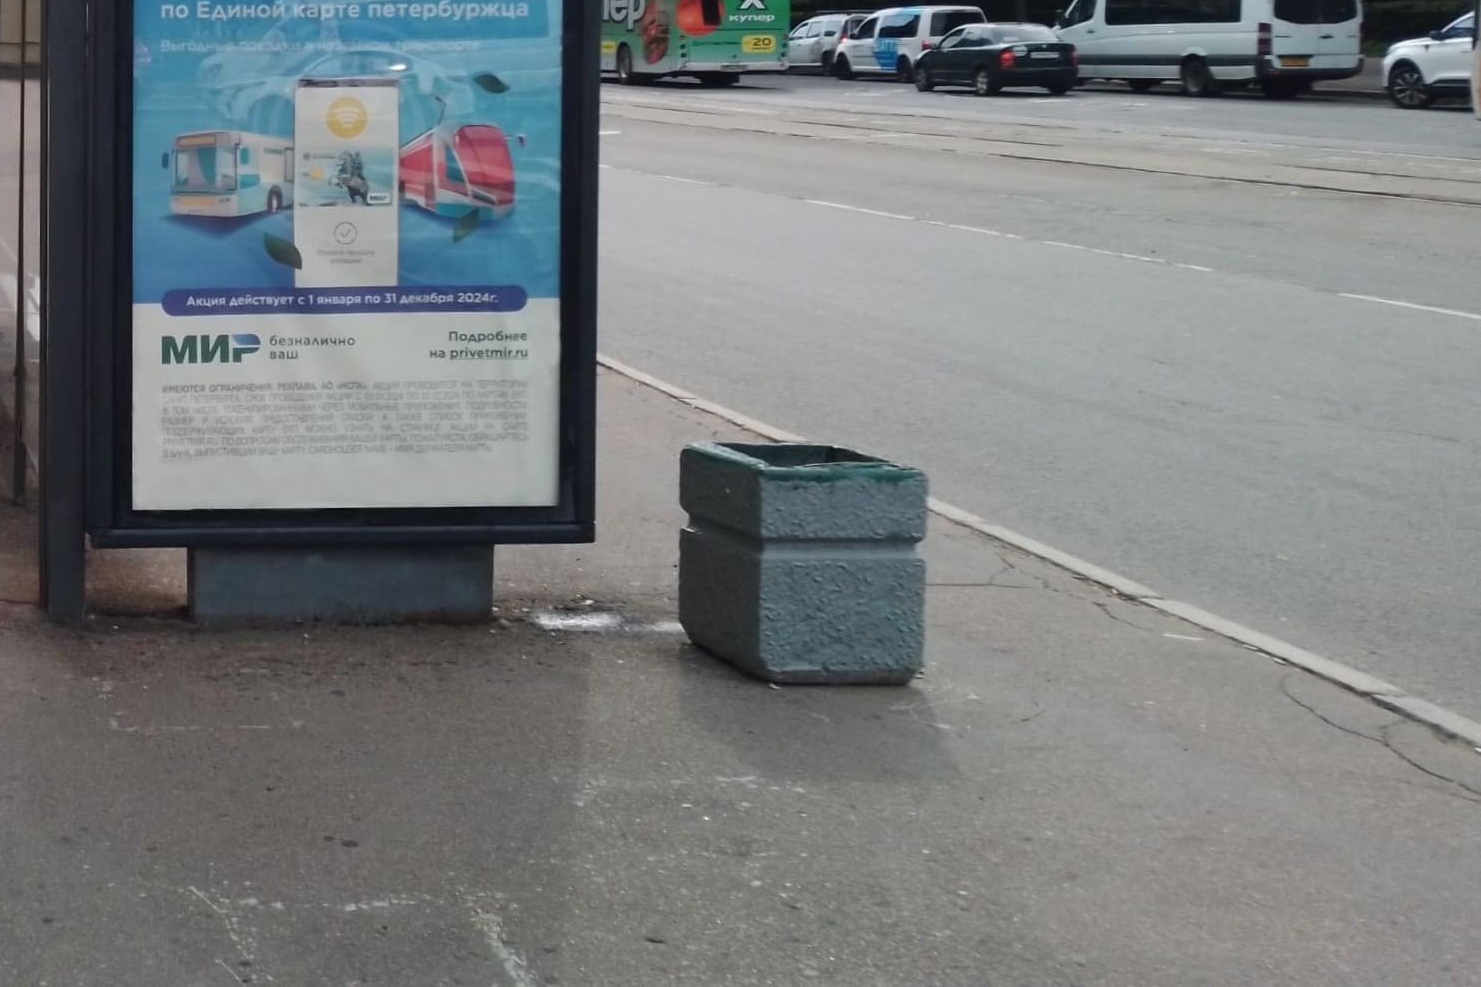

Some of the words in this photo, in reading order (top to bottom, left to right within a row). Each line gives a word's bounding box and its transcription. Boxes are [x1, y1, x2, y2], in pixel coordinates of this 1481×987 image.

[160, 4, 189, 19] по
[196, 0, 286, 21] Единой
[293, 3, 360, 21] карте
[369, 0, 529, 21] петербуржца
[751, 37, 772, 47] 20
[186, 295, 226, 307] Акция
[229, 294, 294, 307] действует
[297, 296, 305, 305] с
[308, 294, 314, 305] 1
[317, 294, 361, 306] января
[365, 294, 381, 304] по
[384, 293, 397, 304] 31
[399, 292, 454, 305] декабря
[269, 334, 356, 347] безналично
[448, 330, 528, 343] Подробнее
[161, 333, 261, 365] МИР
[269, 349, 298, 360] ваш
[430, 349, 446, 359] на
[450, 346, 529, 360] privetmir.ru
